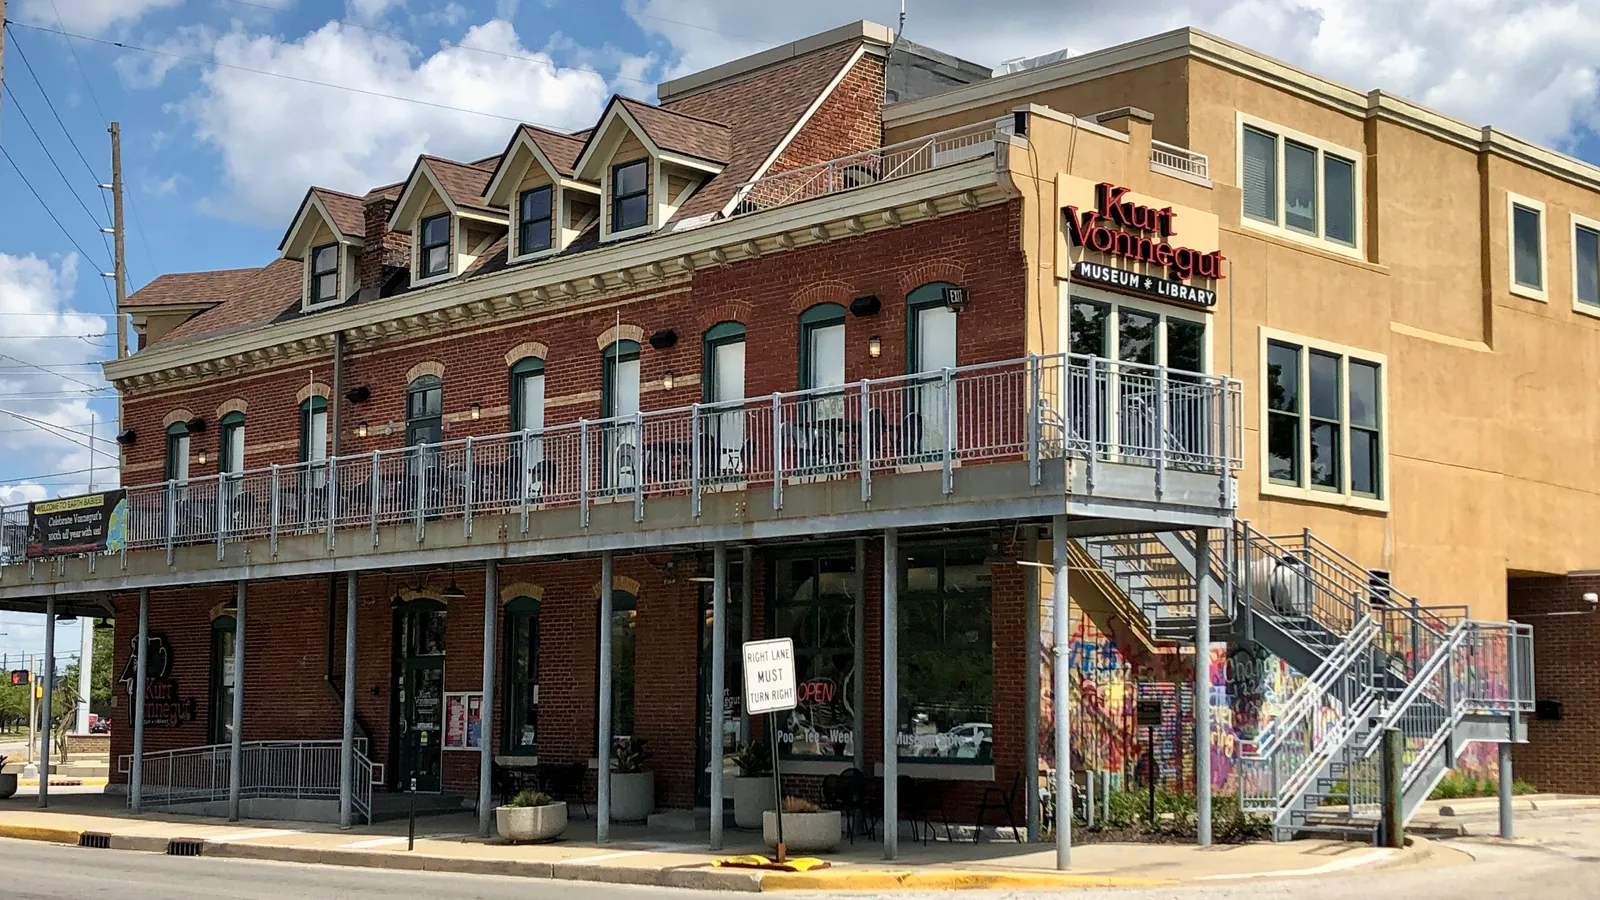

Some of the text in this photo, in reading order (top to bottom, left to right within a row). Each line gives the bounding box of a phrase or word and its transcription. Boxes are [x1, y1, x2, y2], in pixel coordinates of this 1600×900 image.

[1097, 182, 1177, 237] Kurt
[1061, 205, 1226, 281] Vonnegut
[1081, 263, 1214, 305] MUSEUM LIBRARY
[950, 289, 964, 303] EXIT
[36, 504, 59, 513] WELCOME
[60, 501, 67, 510] TO
[68, 499, 83, 509] EARTH
[48, 511, 102, 526] Celebrate Vonnegut's
[70, 530, 81, 540] year
[82, 526, 92, 537] with
[747, 648, 790, 663] RIGHT LANE
[757, 668, 783, 683] MUST
[750, 687, 793, 704] TURN RIGHT
[797, 682, 834, 703] OPEN
[777, 730, 794, 743] Poo
[804, 729, 819, 743] Tee
